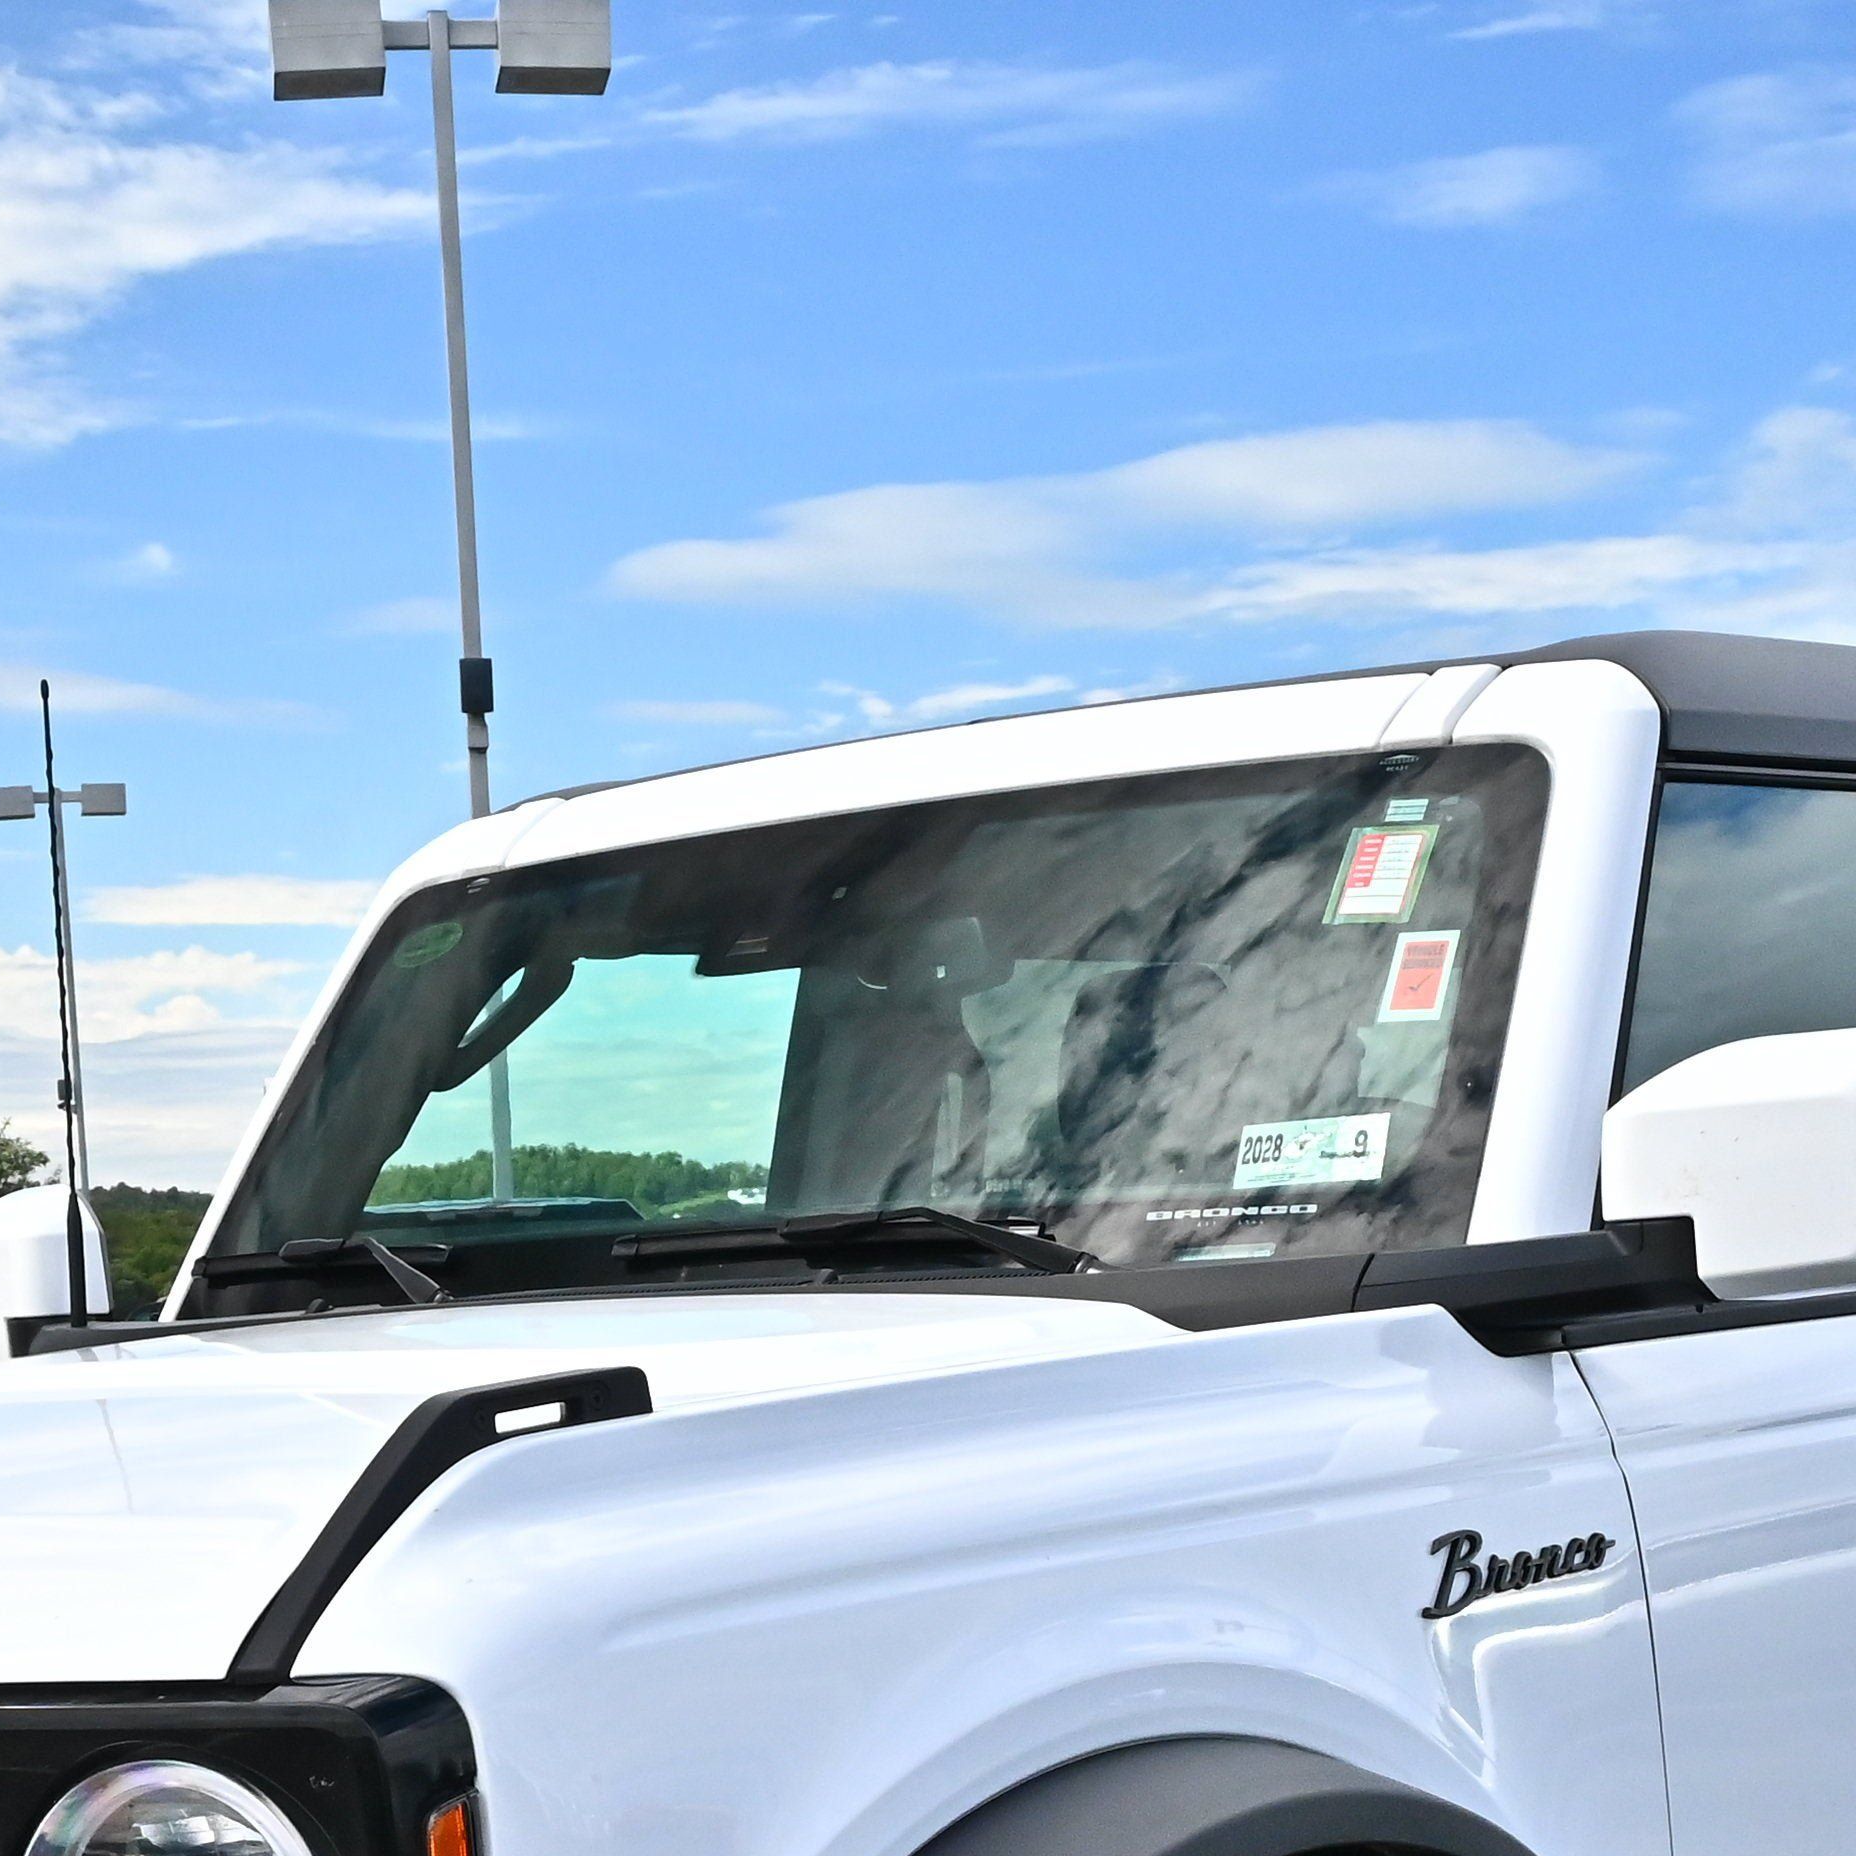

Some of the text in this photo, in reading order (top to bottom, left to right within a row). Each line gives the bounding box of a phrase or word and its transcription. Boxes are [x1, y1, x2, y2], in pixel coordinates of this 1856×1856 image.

[1241, 1129, 1369, 1165] 2028 9
[1146, 1204, 1318, 1221] BRONCO
[1421, 1529, 1617, 1619] Bronco
